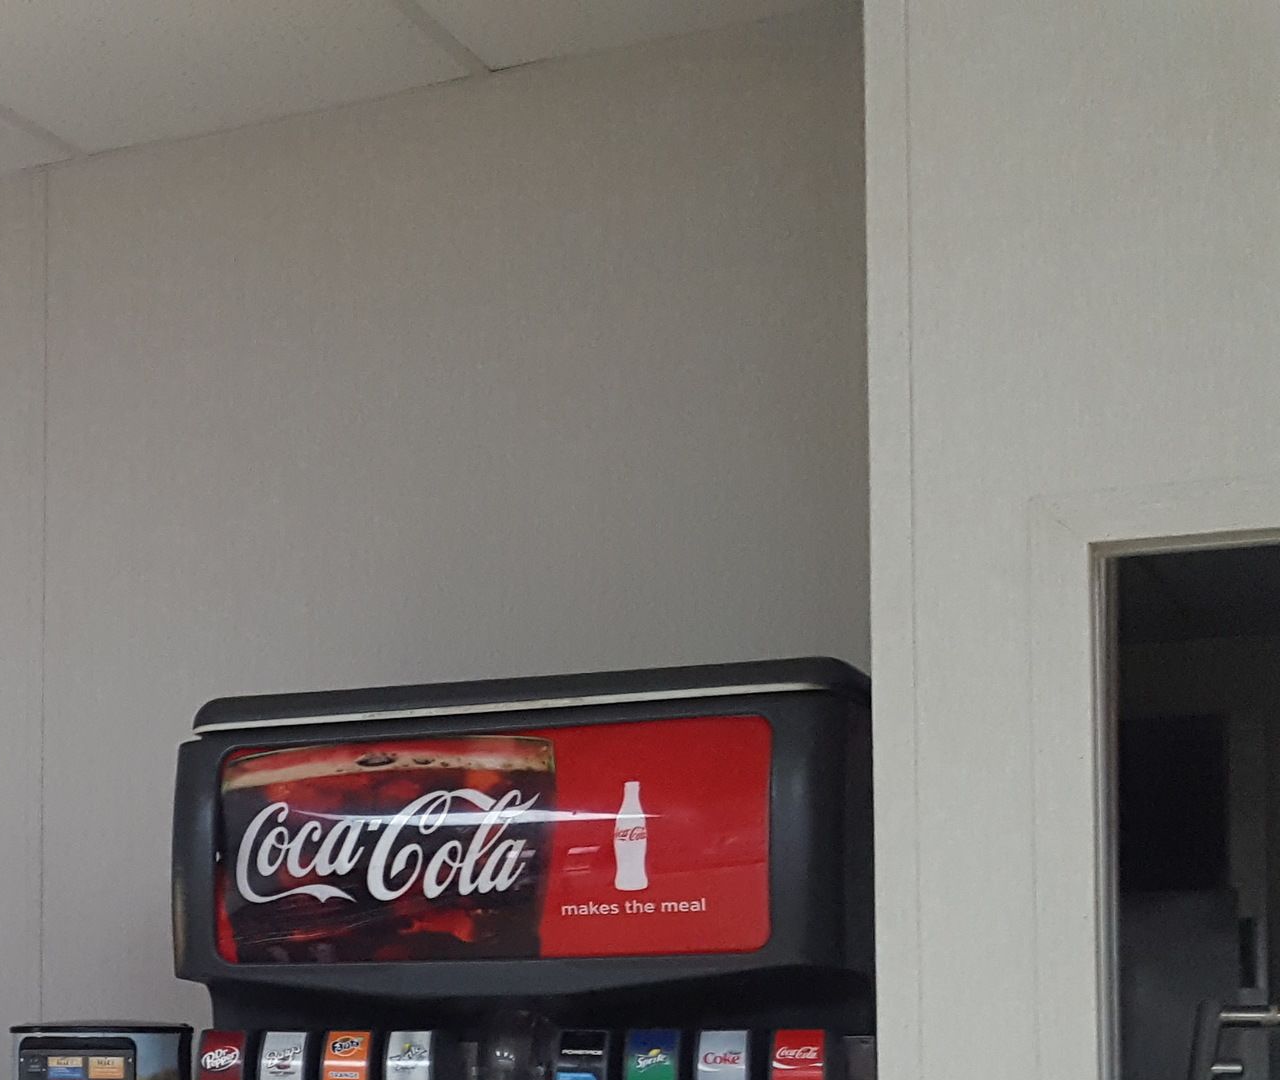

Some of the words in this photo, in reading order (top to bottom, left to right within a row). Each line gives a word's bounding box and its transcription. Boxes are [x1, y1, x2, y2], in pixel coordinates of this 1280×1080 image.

[236, 789, 541, 904] Coca-Cola
[562, 901, 620, 916] makes
[625, 900, 656, 914] the
[661, 898, 707, 913] meal
[215, 1048, 229, 1059] Dr
[703, 1052, 741, 1065] Coke
[776, 1046, 820, 1060] Coca-Cola
[205, 1052, 238, 1070] Pepper
[636, 1054, 669, 1069] Sprite
